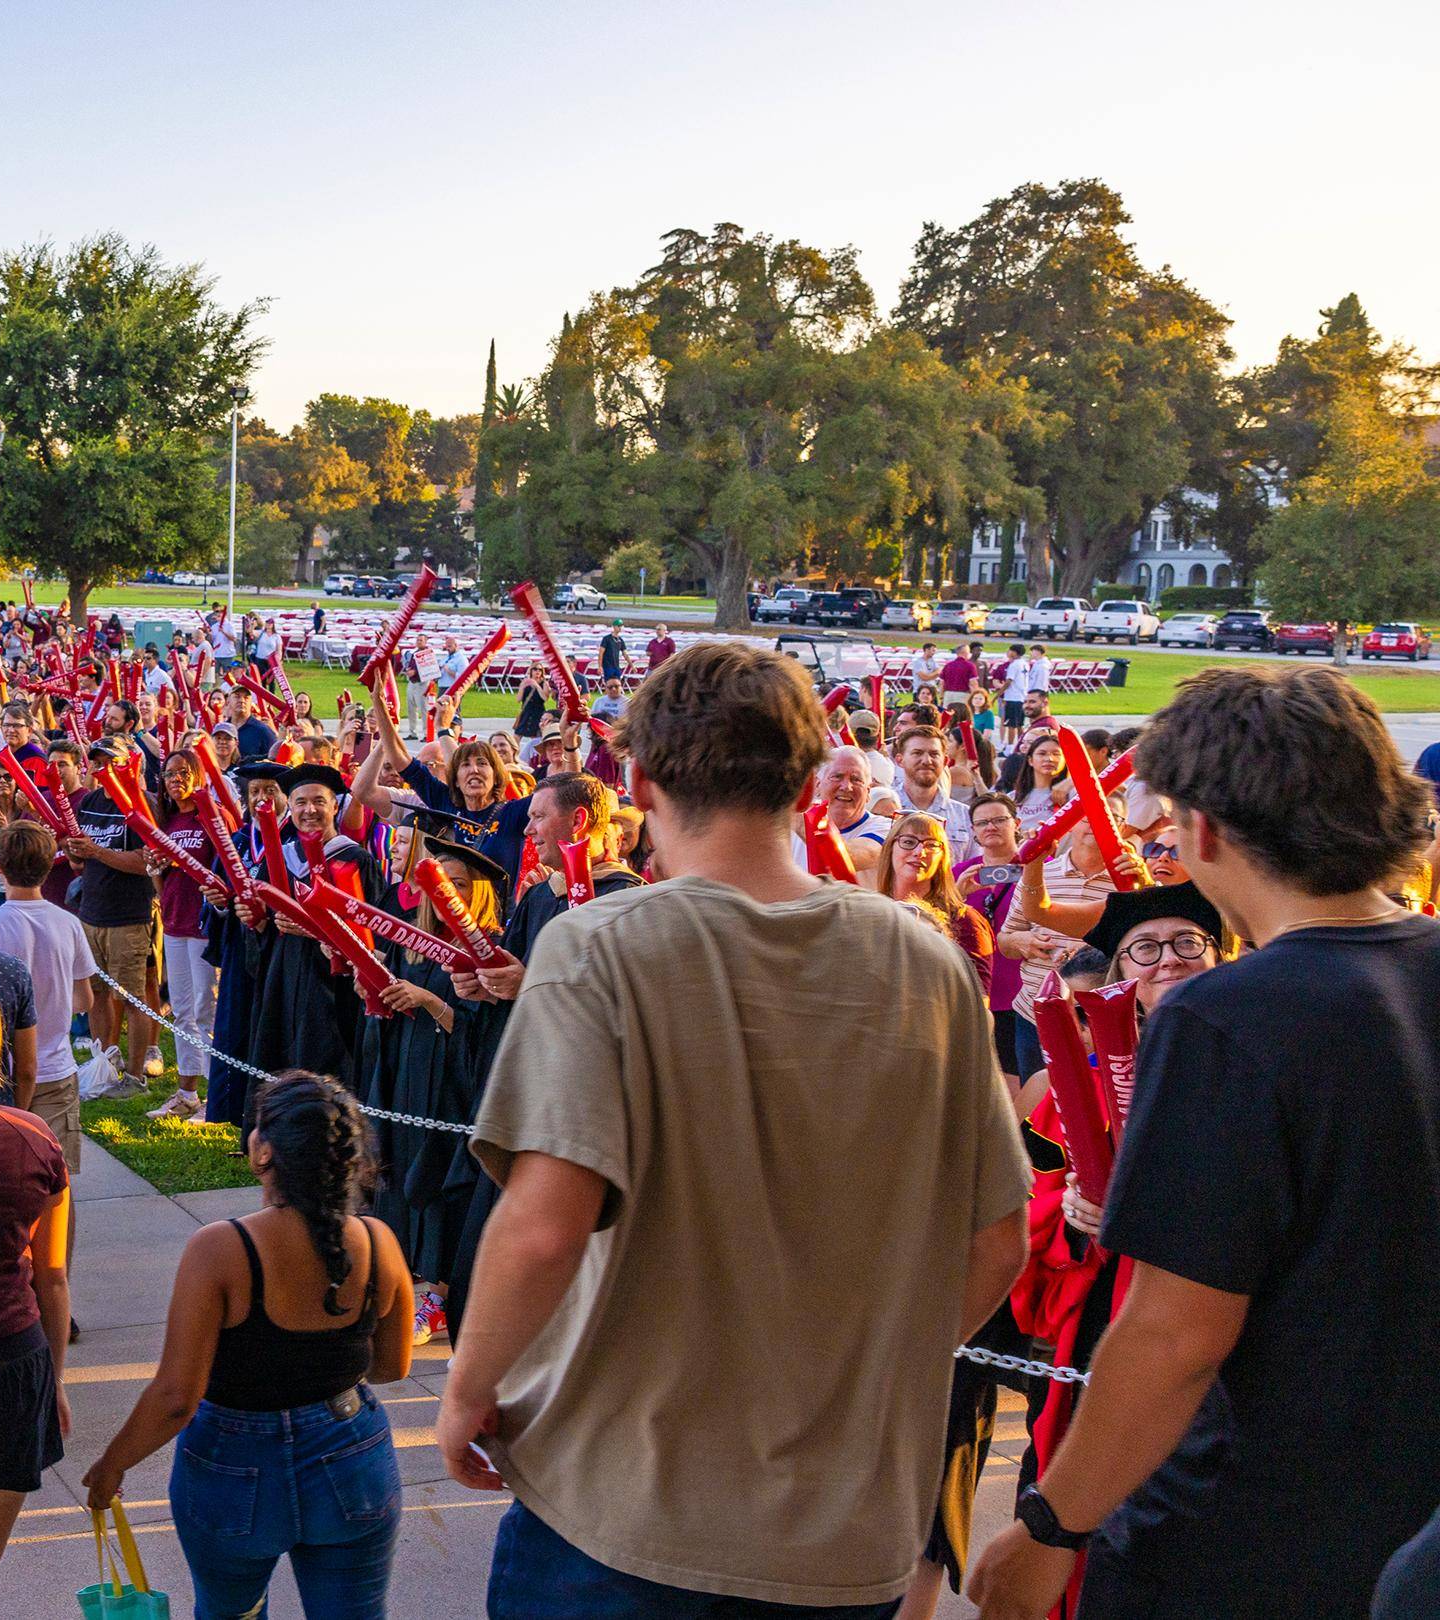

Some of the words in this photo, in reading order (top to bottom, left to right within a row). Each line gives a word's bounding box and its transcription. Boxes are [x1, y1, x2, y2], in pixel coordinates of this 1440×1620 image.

[74, 702, 83, 713] GO
[186, 857, 204, 871] GO
[232, 861, 248, 879] GO
[367, 914, 392, 935] GO
[392, 929, 456, 966] DAWGS!
[446, 896, 466, 917] GO
[458, 911, 495, 961] DAWGS!
[1108, 1054, 1138, 1128] AWGS!
